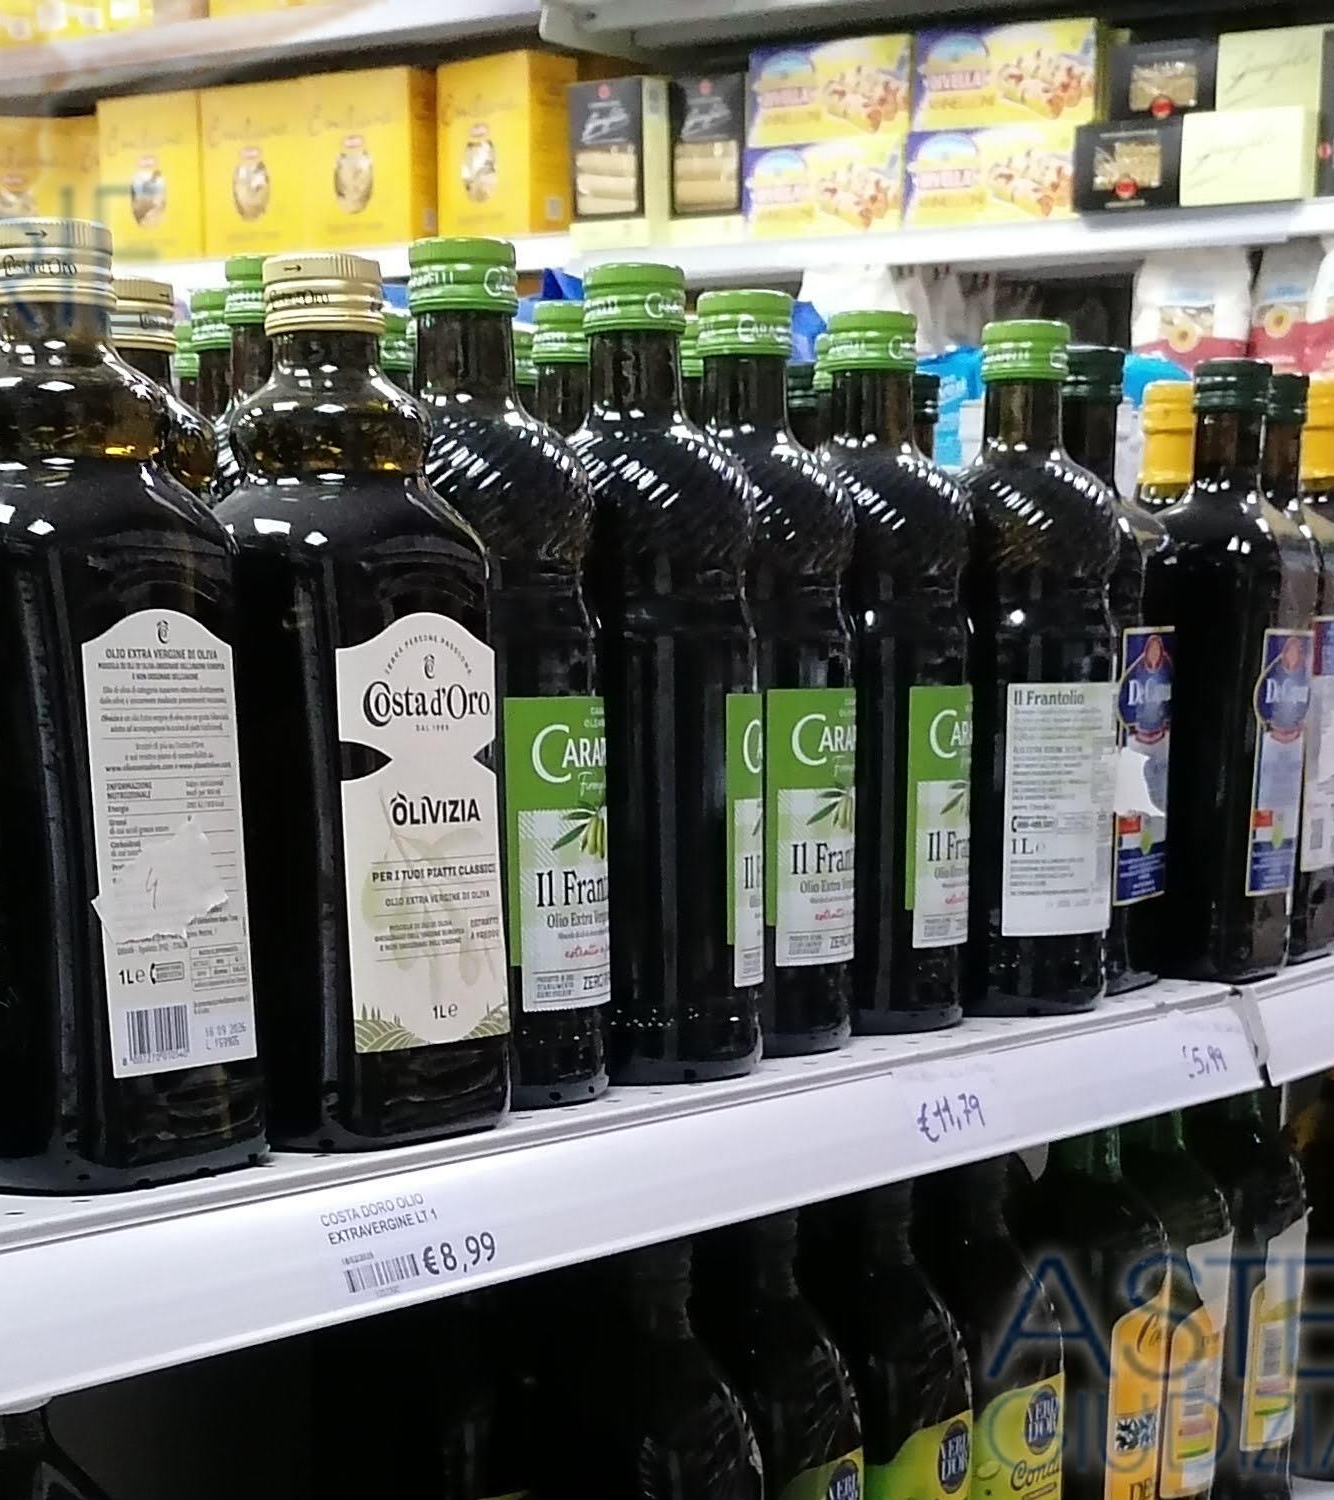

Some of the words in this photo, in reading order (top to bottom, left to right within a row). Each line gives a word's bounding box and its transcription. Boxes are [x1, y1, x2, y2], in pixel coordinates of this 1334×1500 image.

[362, 680, 429, 728] Costa
[429, 683, 490, 720] d'Oro
[1025, 689, 1086, 706] Frantoio
[371, 871, 394, 883] PER
[426, 865, 457, 879] PIATTI
[458, 862, 497, 877] CLASSICI
[546, 913, 570, 929] Olio
[570, 912, 593, 928] Extra
[319, 1208, 361, 1228] COSTA
[360, 1200, 395, 1219] DORO
[395, 1192, 425, 1211] OLIO
[327, 1212, 417, 1246] EXTRAVERGINE
[416, 1208, 430, 1226] LT
[422, 1230, 497, 1276] €8,99
